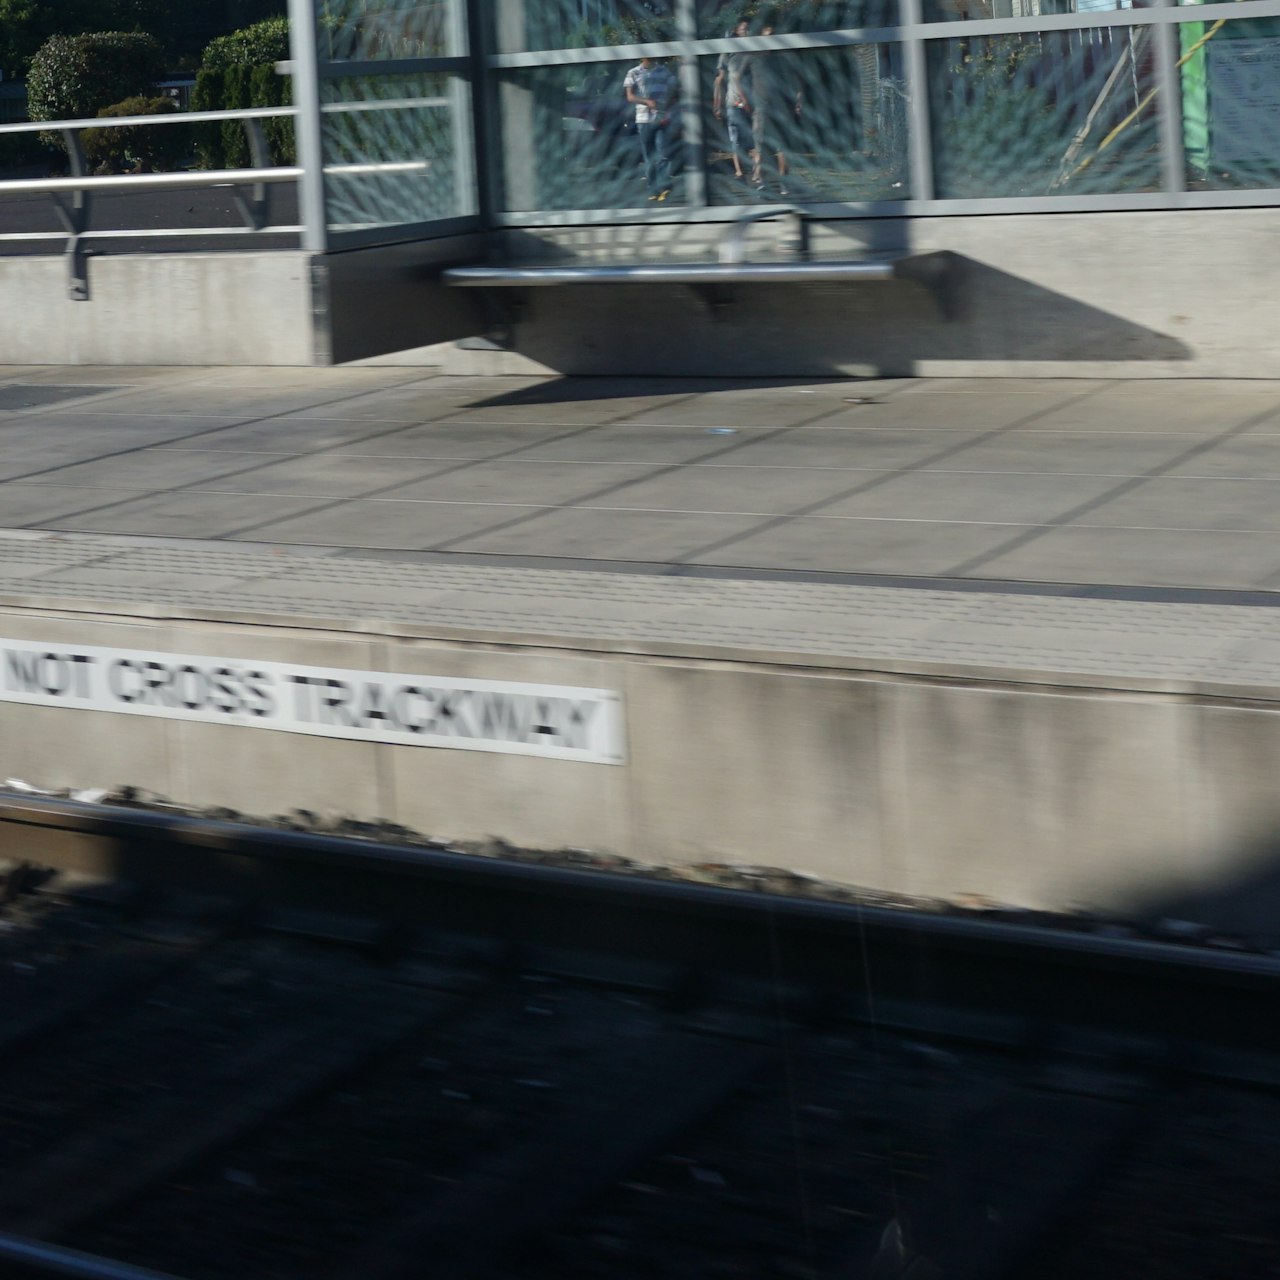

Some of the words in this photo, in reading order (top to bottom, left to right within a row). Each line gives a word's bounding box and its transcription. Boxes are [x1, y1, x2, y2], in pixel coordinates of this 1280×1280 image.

[5, 648, 93, 699] NOT
[109, 658, 272, 717] CROSS
[286, 674, 597, 750] TRACKWAY
